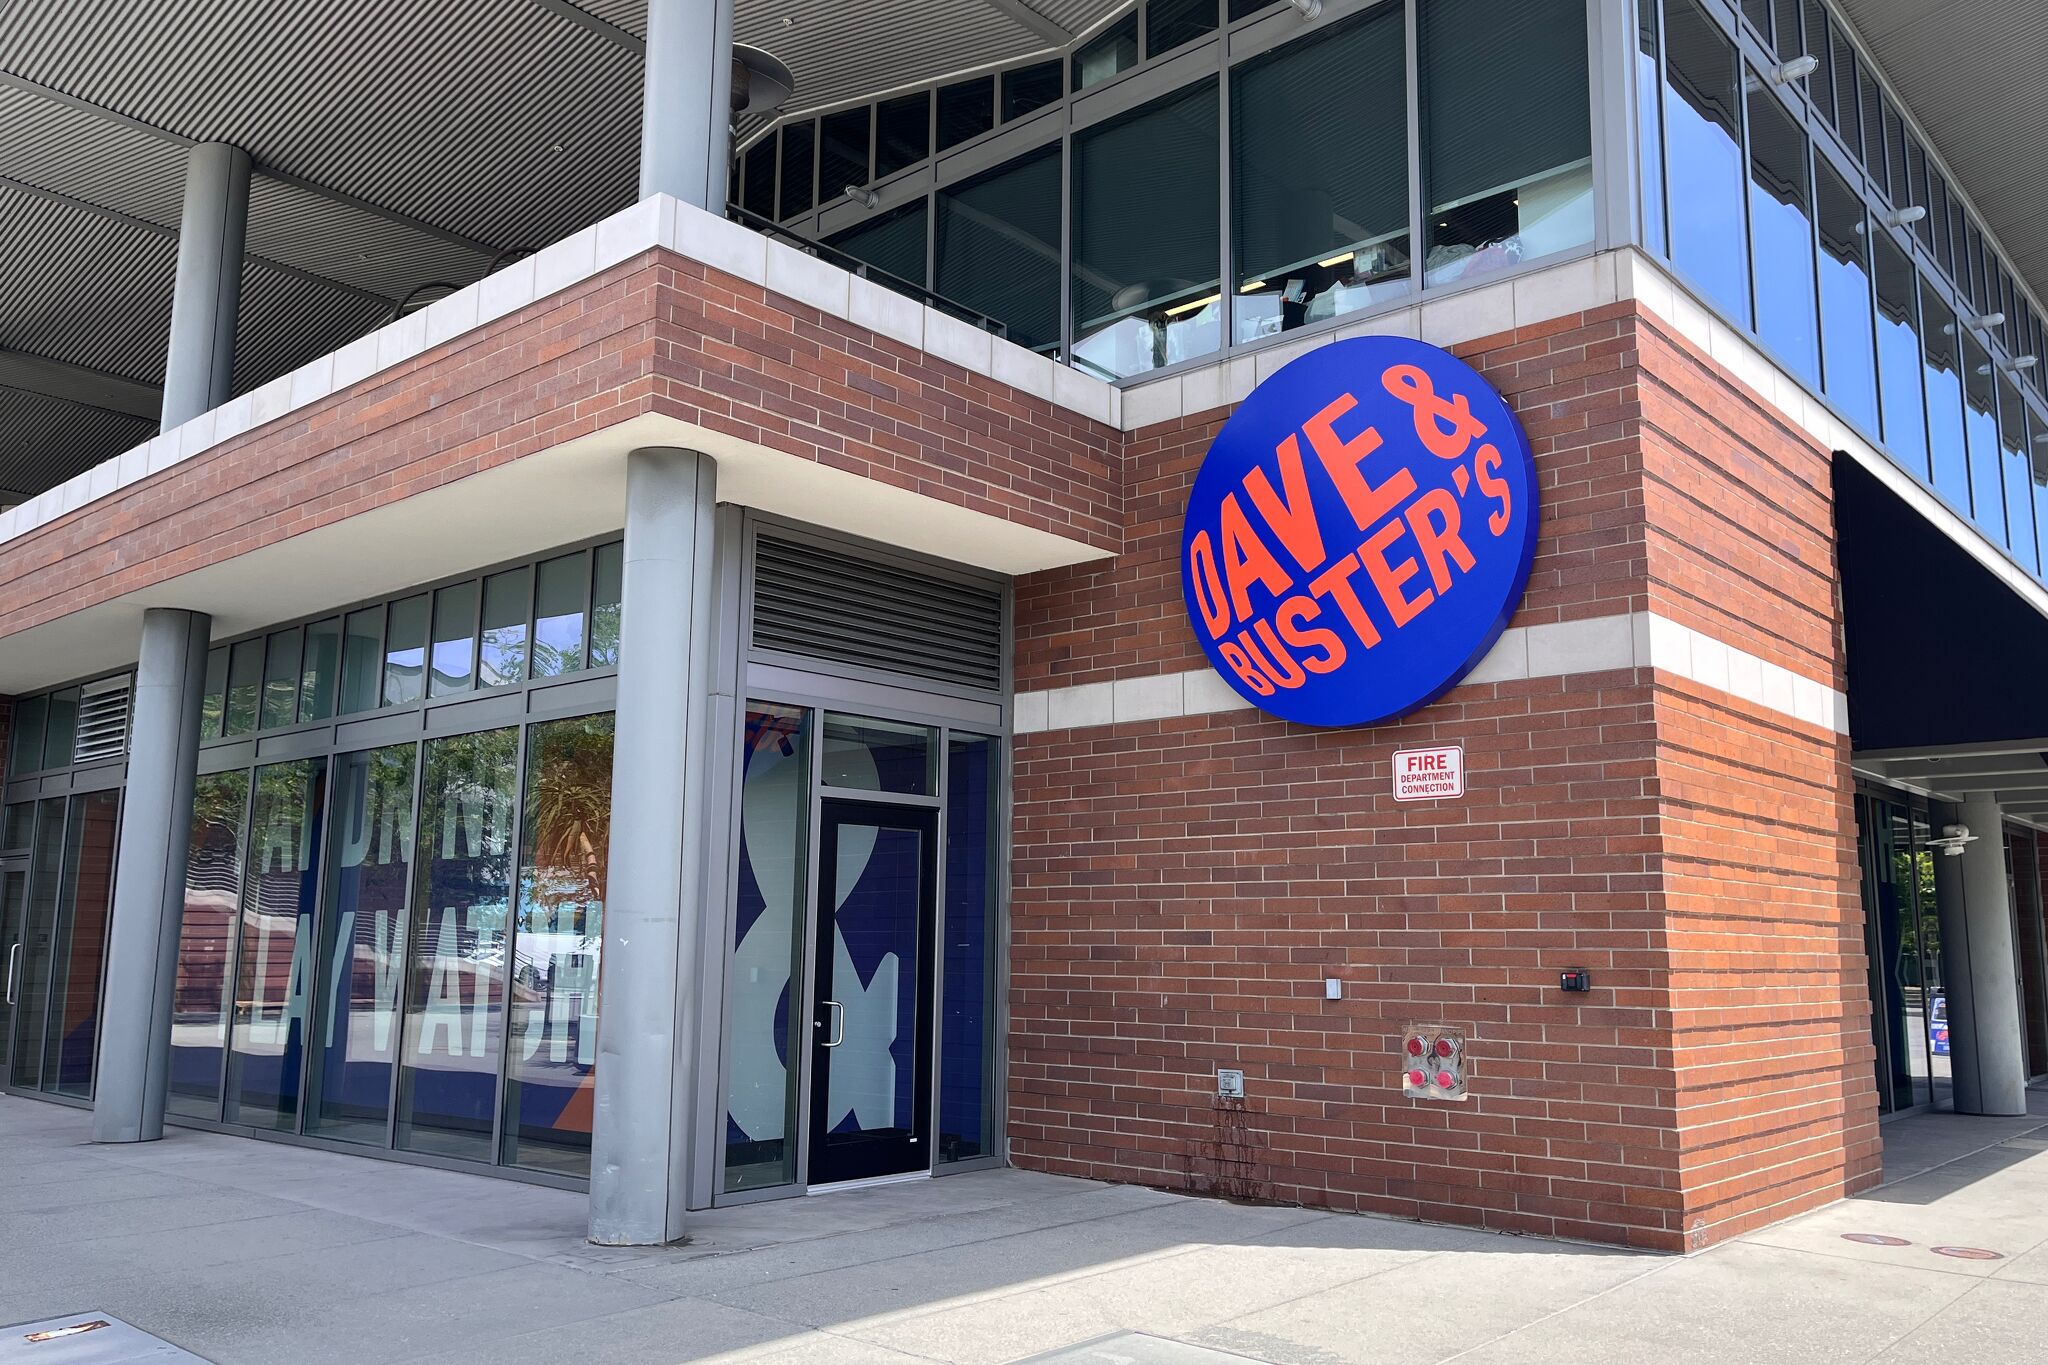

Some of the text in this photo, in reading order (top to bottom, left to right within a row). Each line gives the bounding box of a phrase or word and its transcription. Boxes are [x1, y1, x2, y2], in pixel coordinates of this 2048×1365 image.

[1190, 364, 1488, 640] DAVE &
[1218, 443, 1511, 696] BUSTER'S
[1407, 754, 1447, 771] FIRE
[1400, 771, 1455, 783] DEPARTMENT
[1401, 782, 1455, 794] CONNECTION
